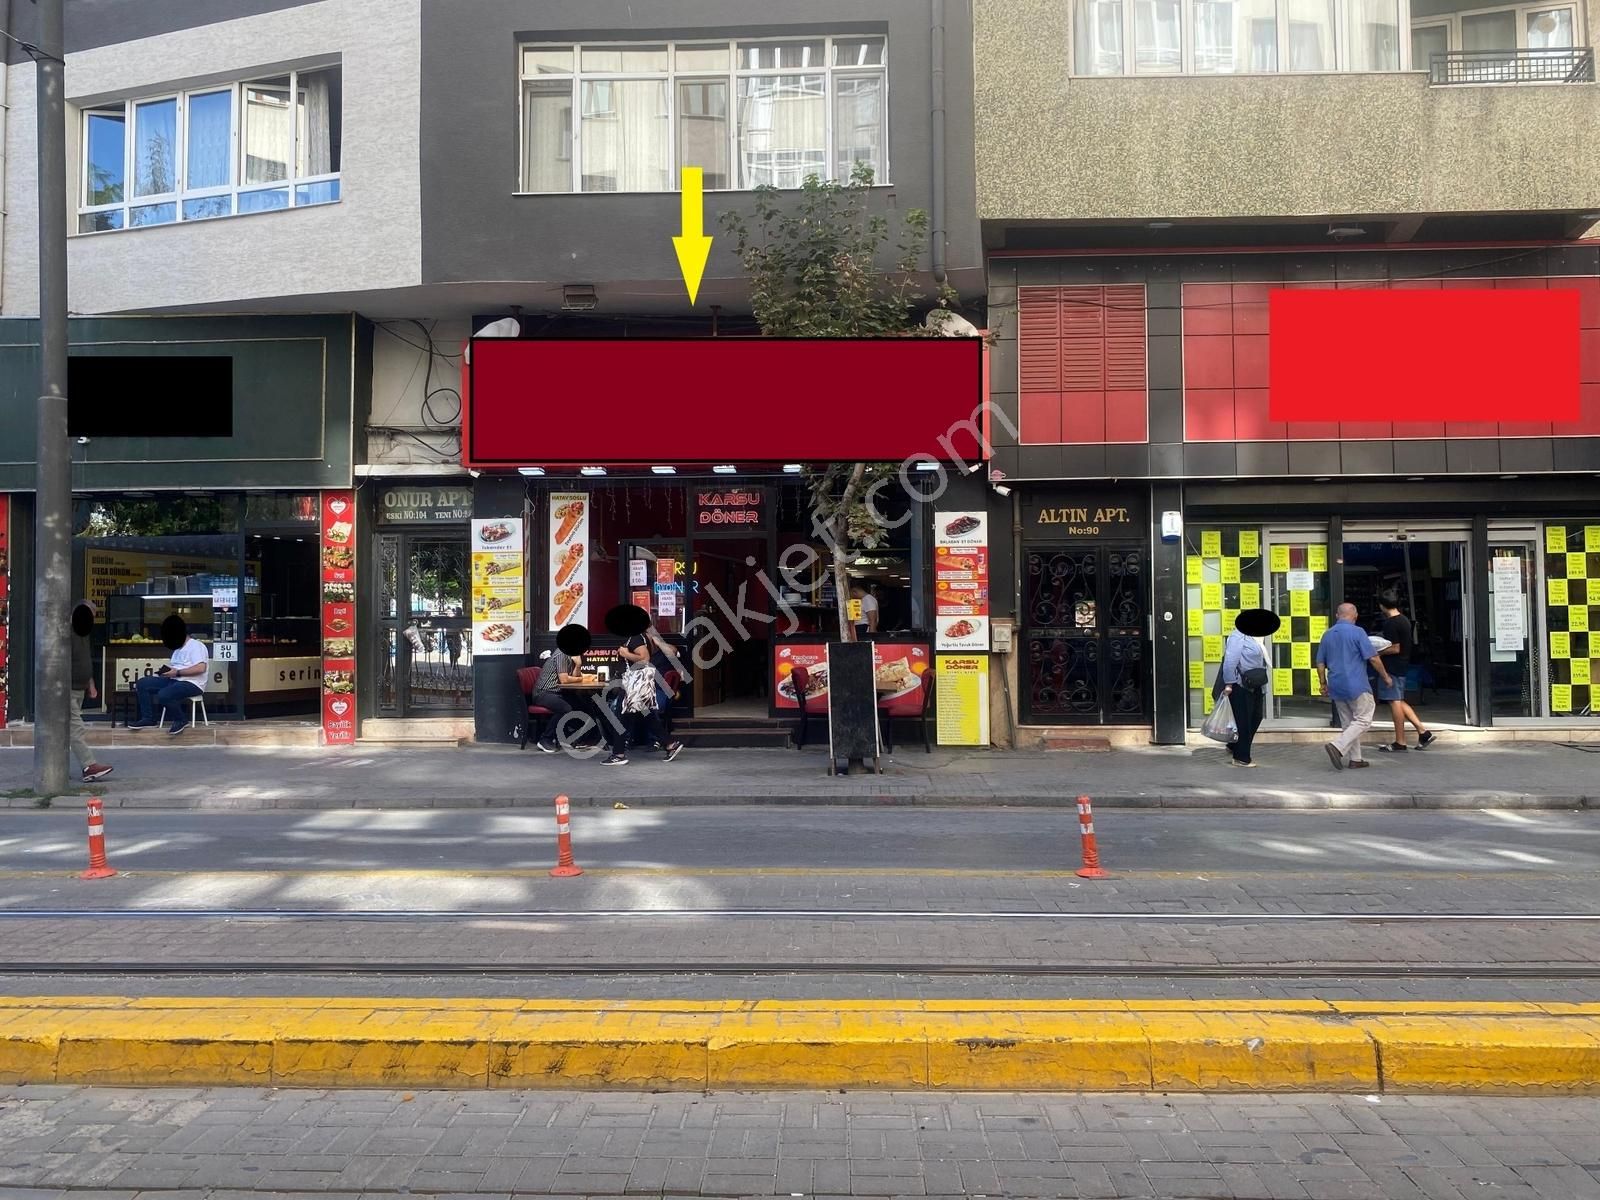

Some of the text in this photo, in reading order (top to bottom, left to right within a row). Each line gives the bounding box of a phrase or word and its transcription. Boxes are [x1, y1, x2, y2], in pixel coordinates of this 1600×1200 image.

[384, 492, 434, 507] ONUR
[699, 493, 760, 505] KARSU
[403, 510, 427, 519] NO:104
[699, 509, 758, 524] DÖNER
[1037, 508, 1130, 523] ALTIN APT.
[1068, 527, 1100, 535] No:90
